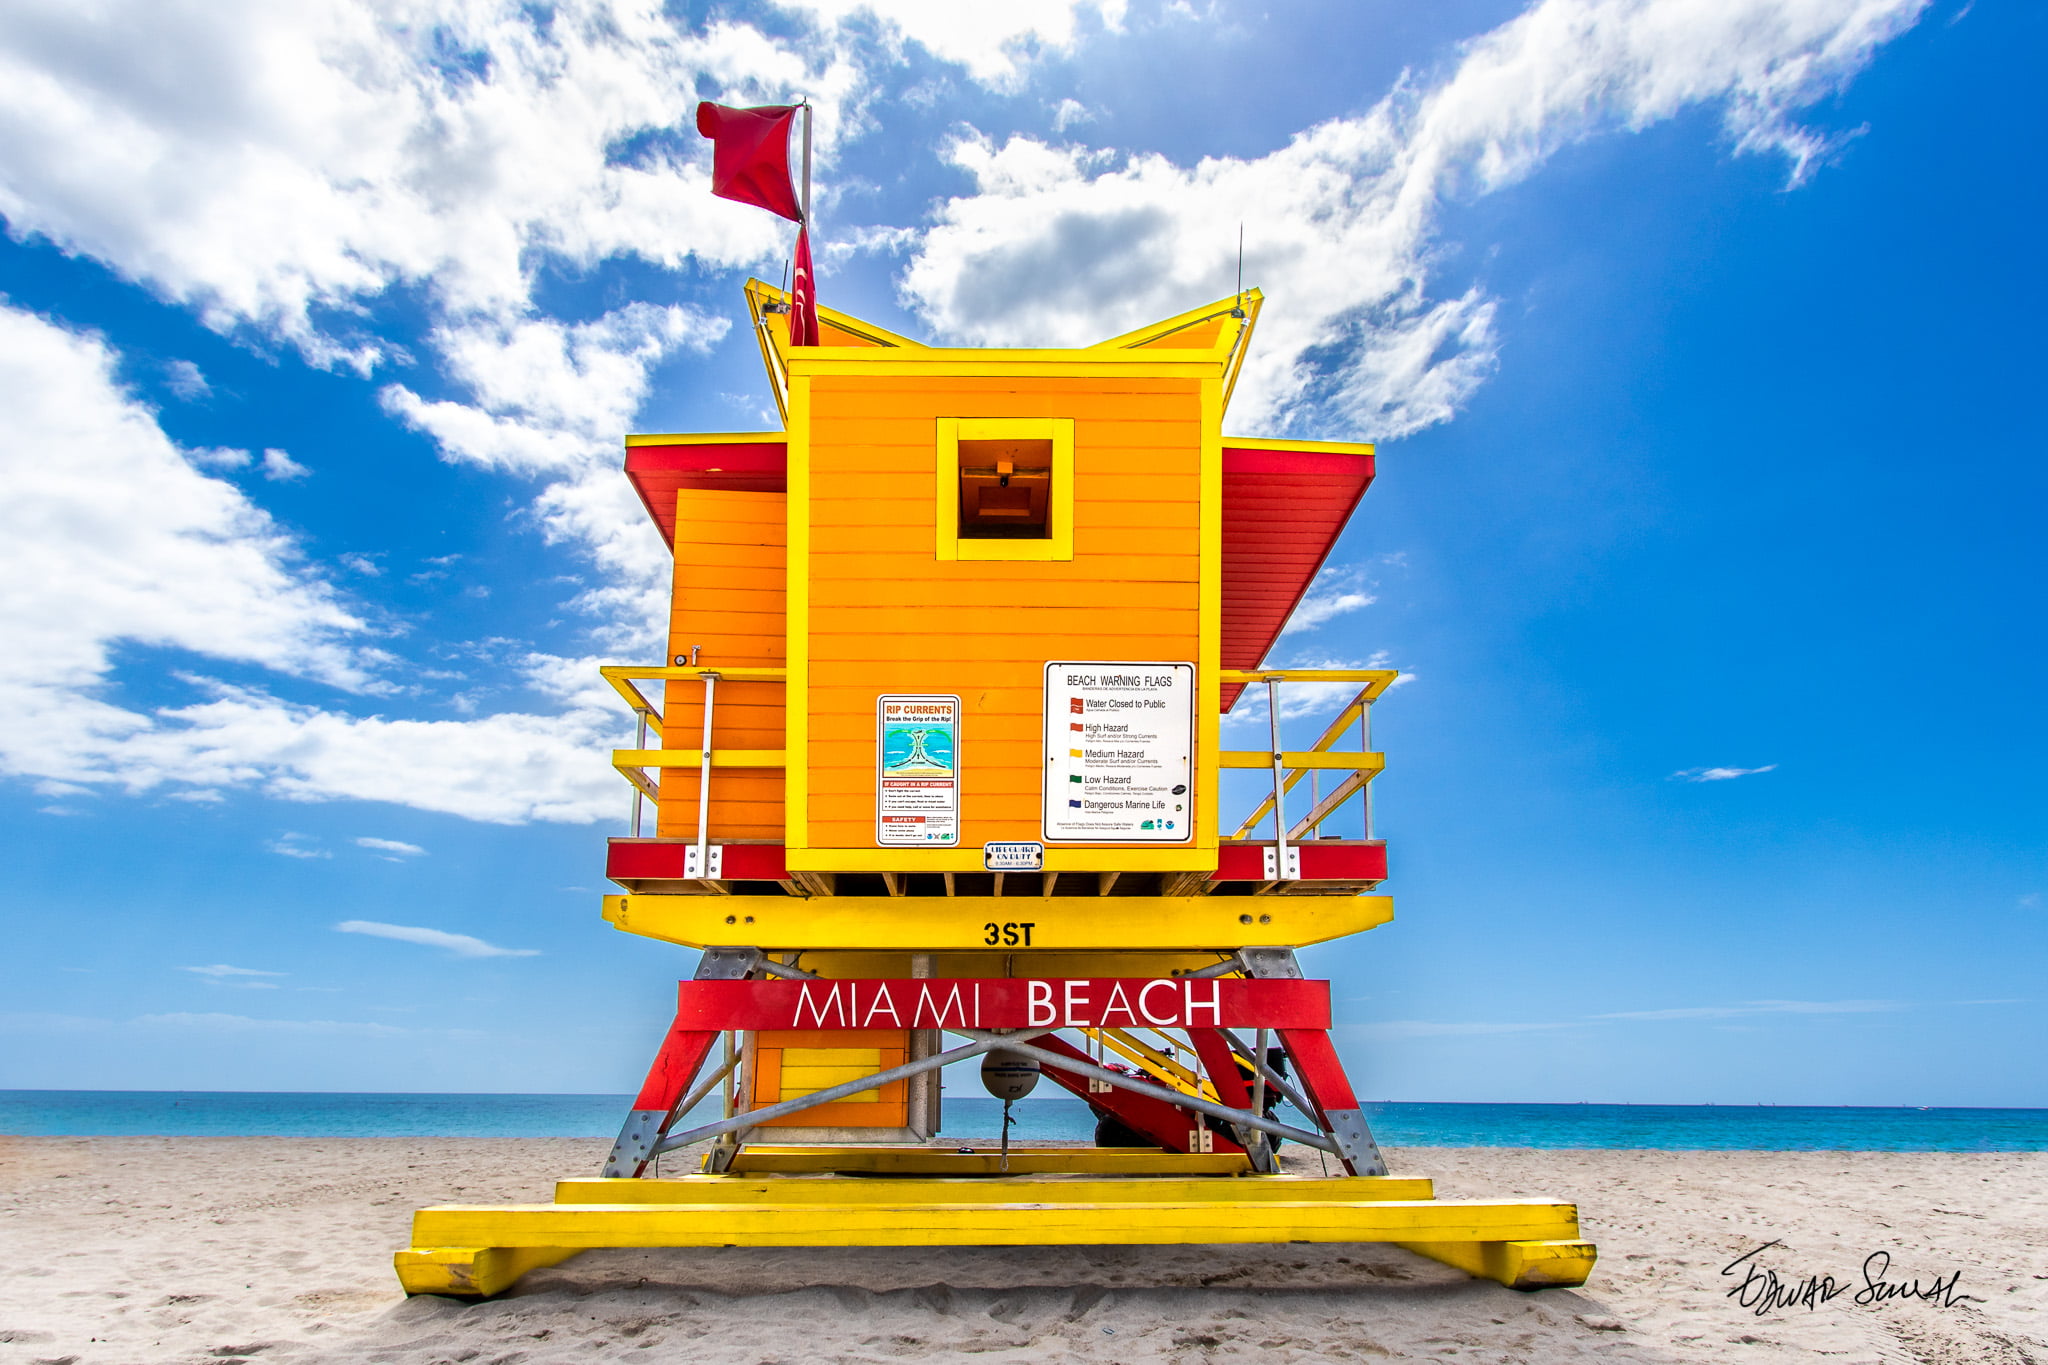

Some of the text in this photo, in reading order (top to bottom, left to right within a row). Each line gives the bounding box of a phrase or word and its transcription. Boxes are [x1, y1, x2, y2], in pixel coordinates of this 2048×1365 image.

[1067, 675, 1172, 687] BEACH WARNING FLAGS
[1086, 699, 1166, 708] Water Closed to Public
[886, 706, 952, 714] RIP CURRENTS
[1085, 723, 1128, 734] High Hazard
[1085, 750, 1144, 758] Medium Hazard
[1084, 800, 1166, 811] Dangerous Marine Life
[984, 922, 1035, 946] 3ST
[792, 979, 1221, 1028] MIAMI BEACH
